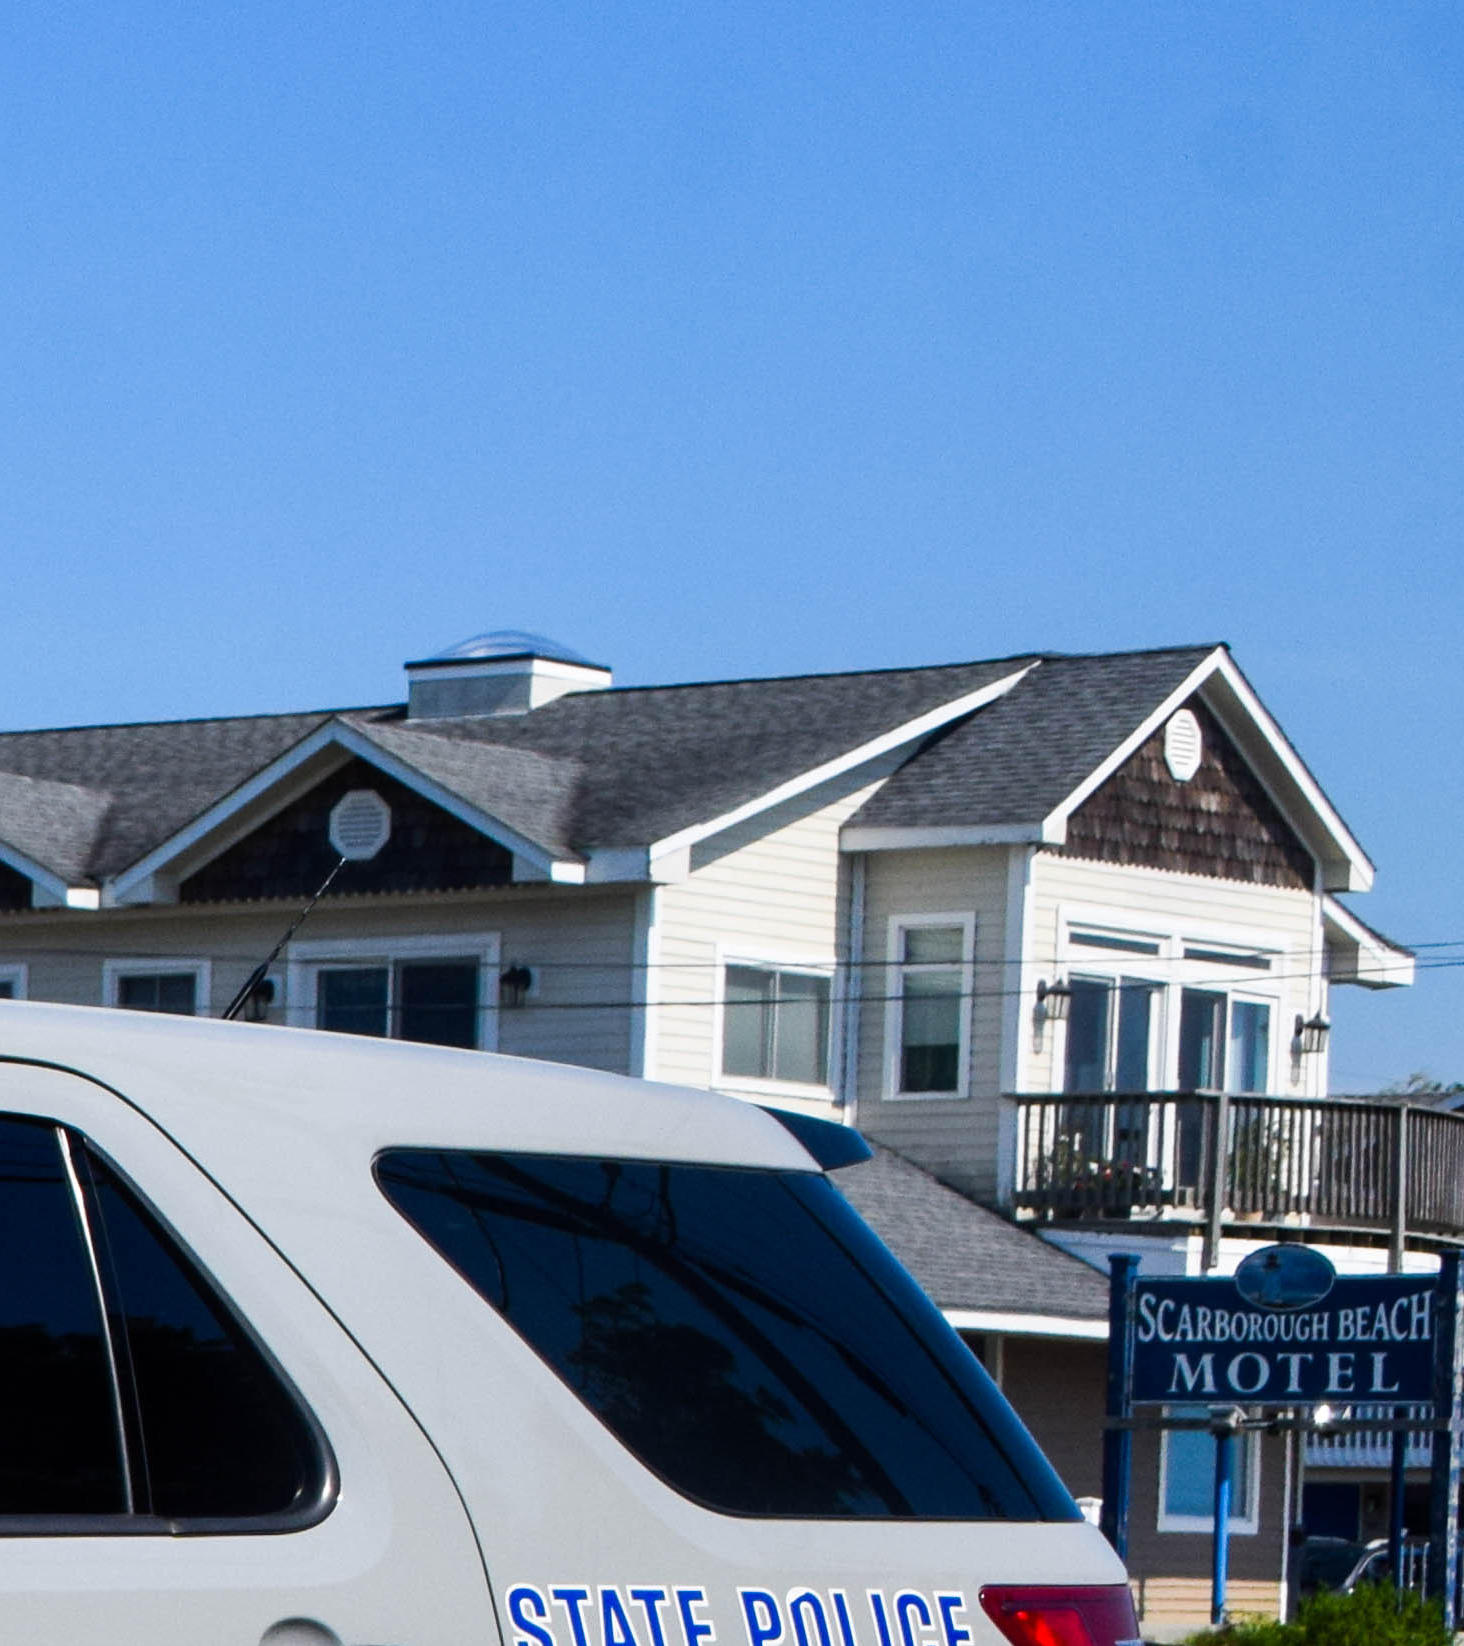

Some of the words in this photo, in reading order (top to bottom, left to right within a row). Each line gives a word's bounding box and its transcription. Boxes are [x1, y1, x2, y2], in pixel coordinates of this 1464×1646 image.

[1137, 1292, 1330, 1343] SCARBOROUGH
[1337, 1290, 1433, 1341] BEACH
[1167, 1352, 1400, 1393] MOTEL
